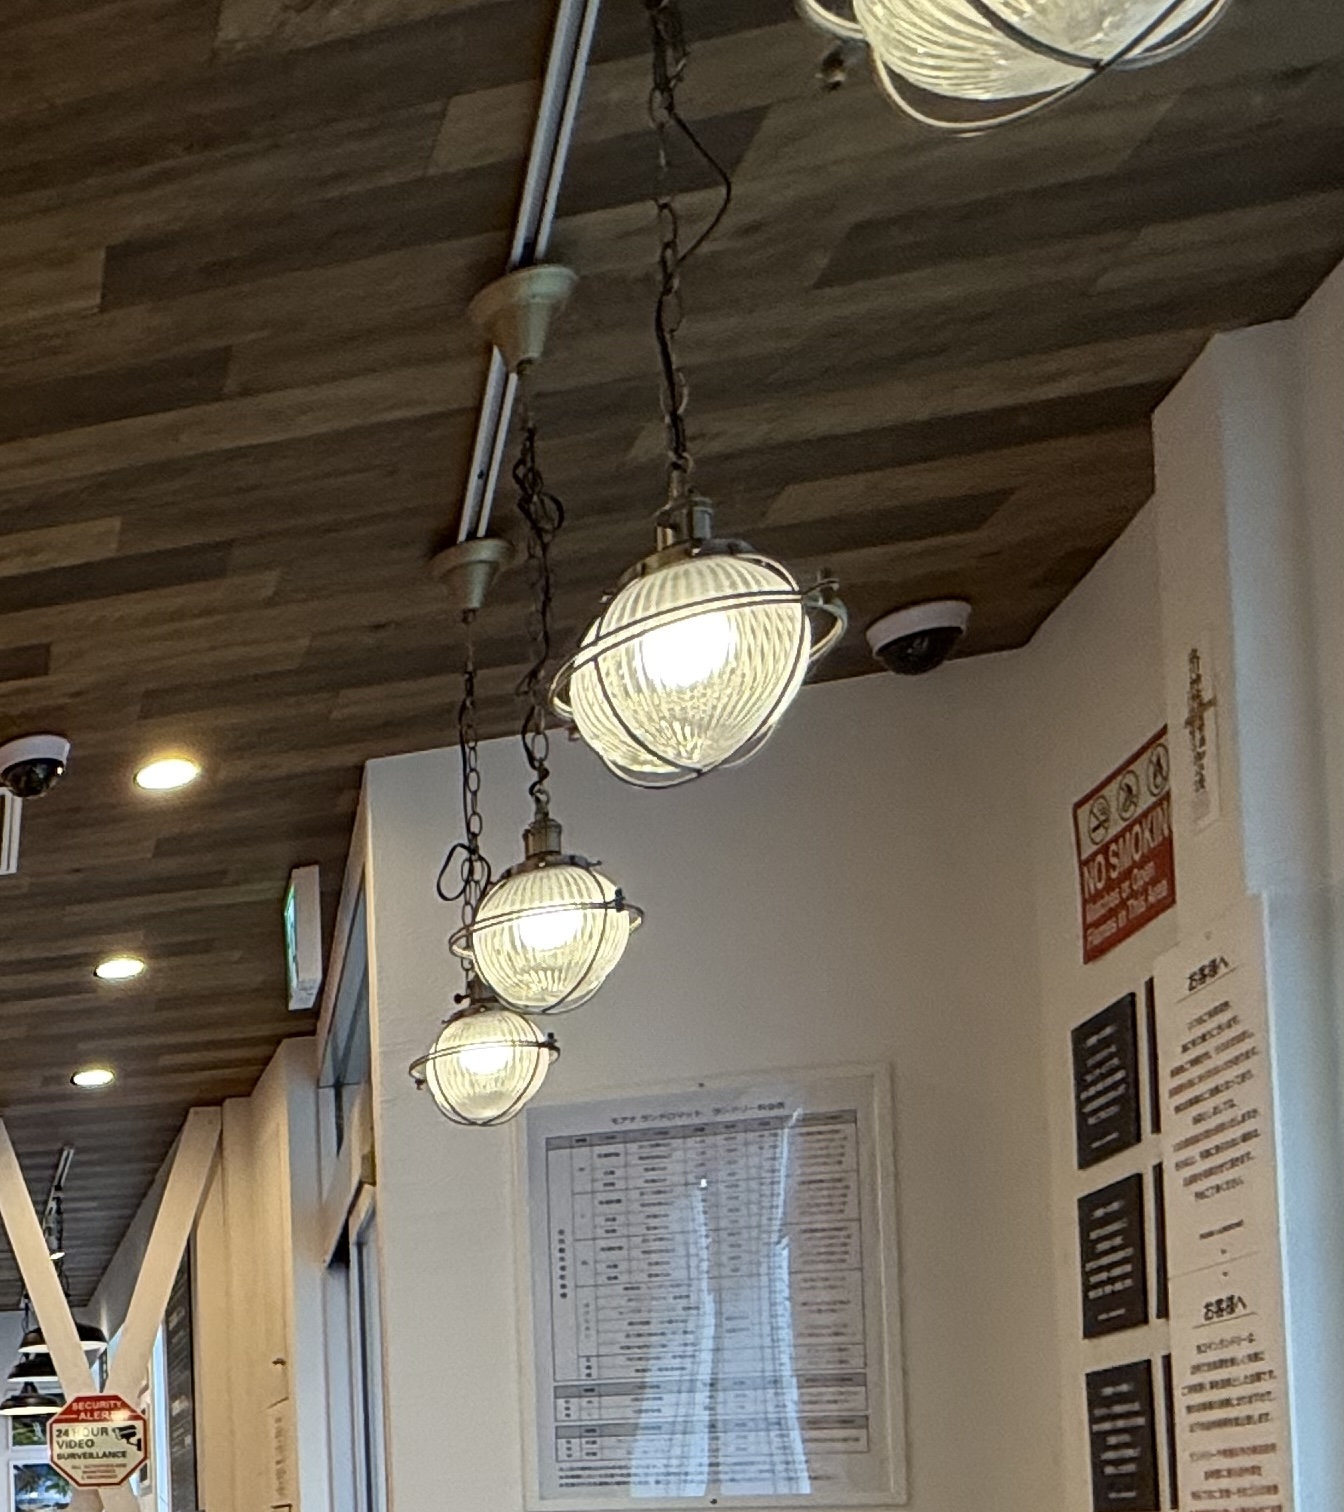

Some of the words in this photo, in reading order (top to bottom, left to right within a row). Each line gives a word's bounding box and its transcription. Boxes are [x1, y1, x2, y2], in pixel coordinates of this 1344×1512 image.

[72, 1401, 123, 1410] SECURITY
[79, 1410, 118, 1420] ALER
[56, 1429, 69, 1438] 24
[57, 1439, 95, 1449] VIDEO
[57, 1450, 127, 1460] SURVEILLANCE
